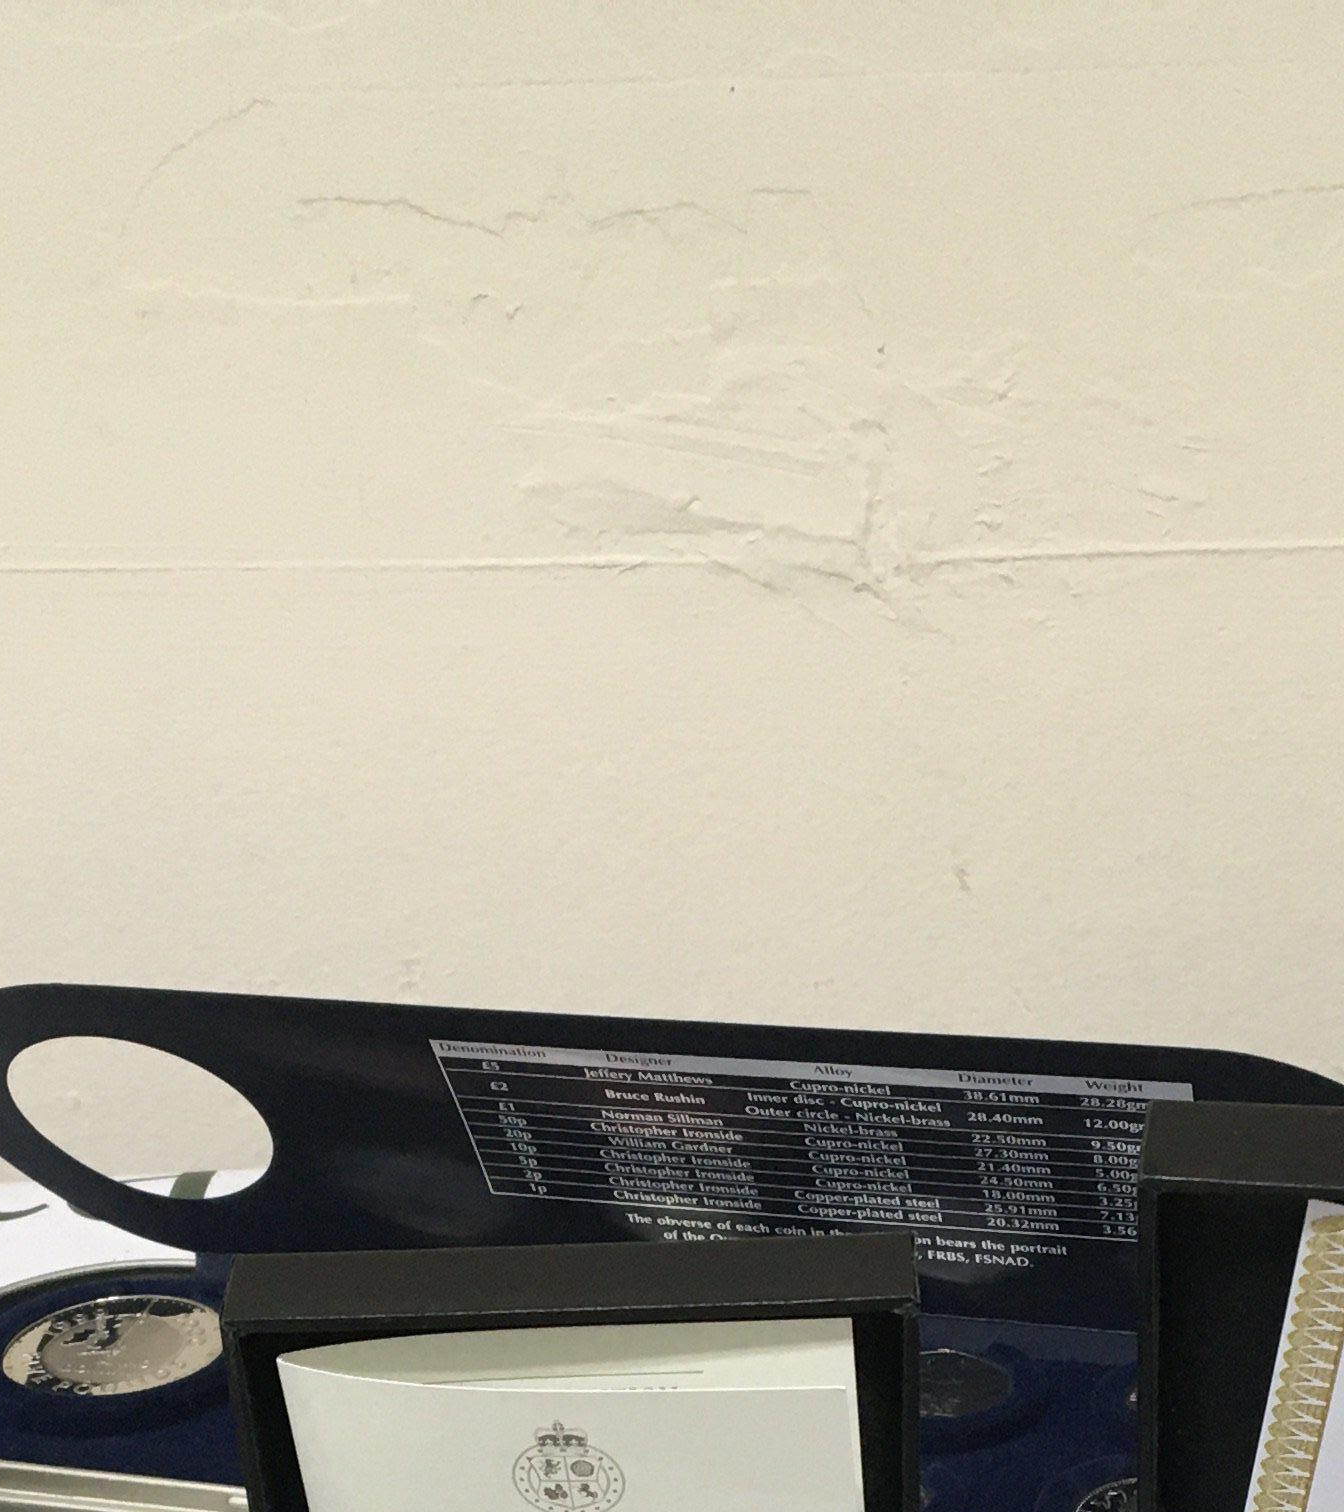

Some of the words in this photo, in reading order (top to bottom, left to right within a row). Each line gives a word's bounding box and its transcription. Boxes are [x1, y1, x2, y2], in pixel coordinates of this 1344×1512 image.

[439, 1042, 547, 1059] Denomination
[605, 1053, 673, 1068] Designer
[583, 1067, 635, 1084] Jeffery
[637, 1070, 714, 1086] Matthews
[813, 1065, 854, 1079] Alloy
[957, 1072, 1034, 1087] Diameter
[789, 1080, 892, 1096] Cupro-nickel
[1084, 1079, 1144, 1094] Weight
[604, 1088, 650, 1102] Bruce
[653, 1091, 706, 1105] Rushin
[747, 1092, 788, 1105] Inner
[793, 1094, 825, 1106] disc
[840, 1097, 943, 1113] Cupro-nickel
[601, 1109, 663, 1124] Norman
[666, 1113, 724, 1127] Sillman
[744, 1105, 792, 1118] Outer
[796, 1108, 839, 1121] circle
[855, 1111, 951, 1127] Nickel-brass
[966, 1111, 1044, 1126] 28.40mm
[608, 1136, 667, 1151] William
[671, 1140, 733, 1155] Gardner
